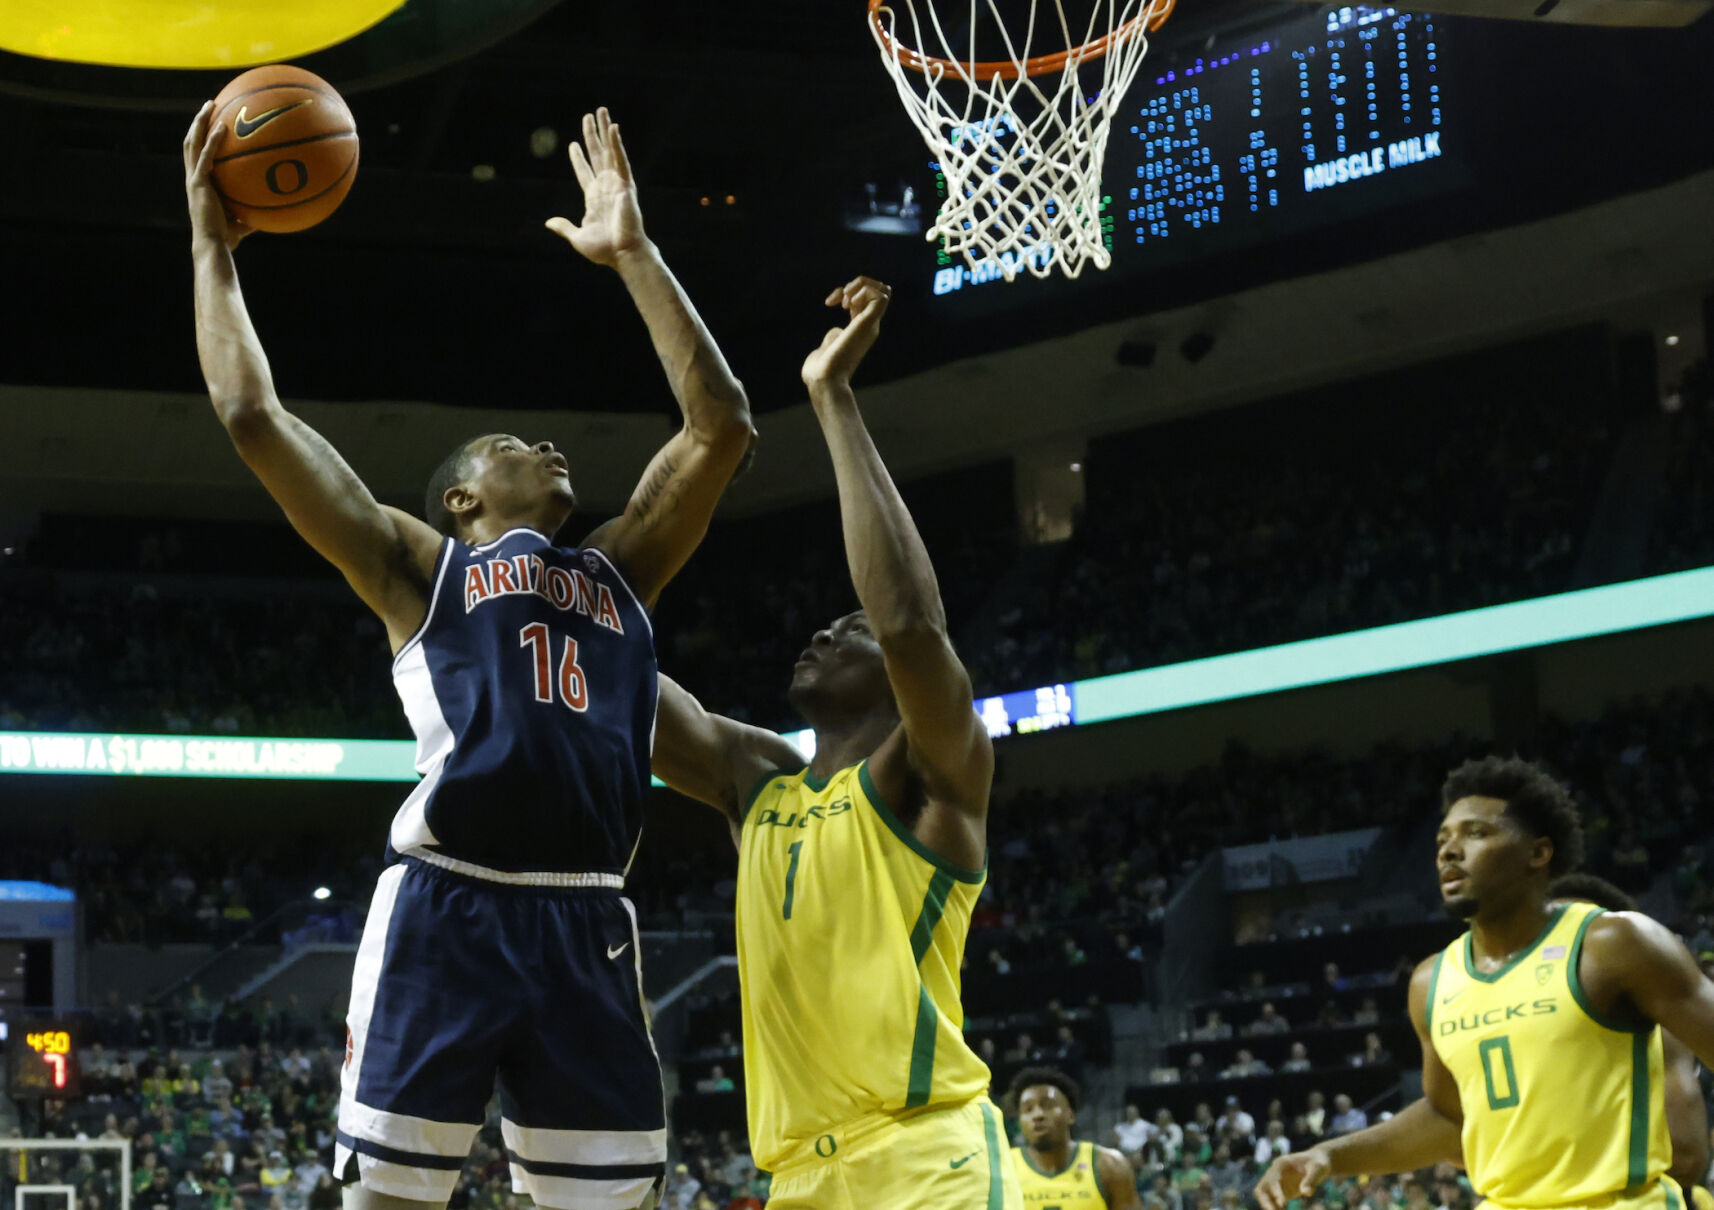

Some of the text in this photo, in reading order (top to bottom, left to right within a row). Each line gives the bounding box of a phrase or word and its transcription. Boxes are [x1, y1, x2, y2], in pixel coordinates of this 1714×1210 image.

[265, 158, 309, 196] O
[1304, 131, 1442, 192] MUSCLE MILK
[464, 553, 624, 635] ARIZONA
[519, 621, 588, 713] 16
[0, 736, 31, 768] TO
[32, 737, 85, 769] WIN
[87, 738, 106, 769] A
[186, 741, 344, 774] SCHOLARSHIP
[757, 795, 852, 829] DUCKS
[782, 840, 804, 920] 1
[1440, 998, 1557, 1037] DUCKS
[26, 1031, 70, 1054] 4:50
[43, 1053, 66, 1088] 7
[1479, 1035, 1520, 1111] 0
[815, 1133, 837, 1159] O
